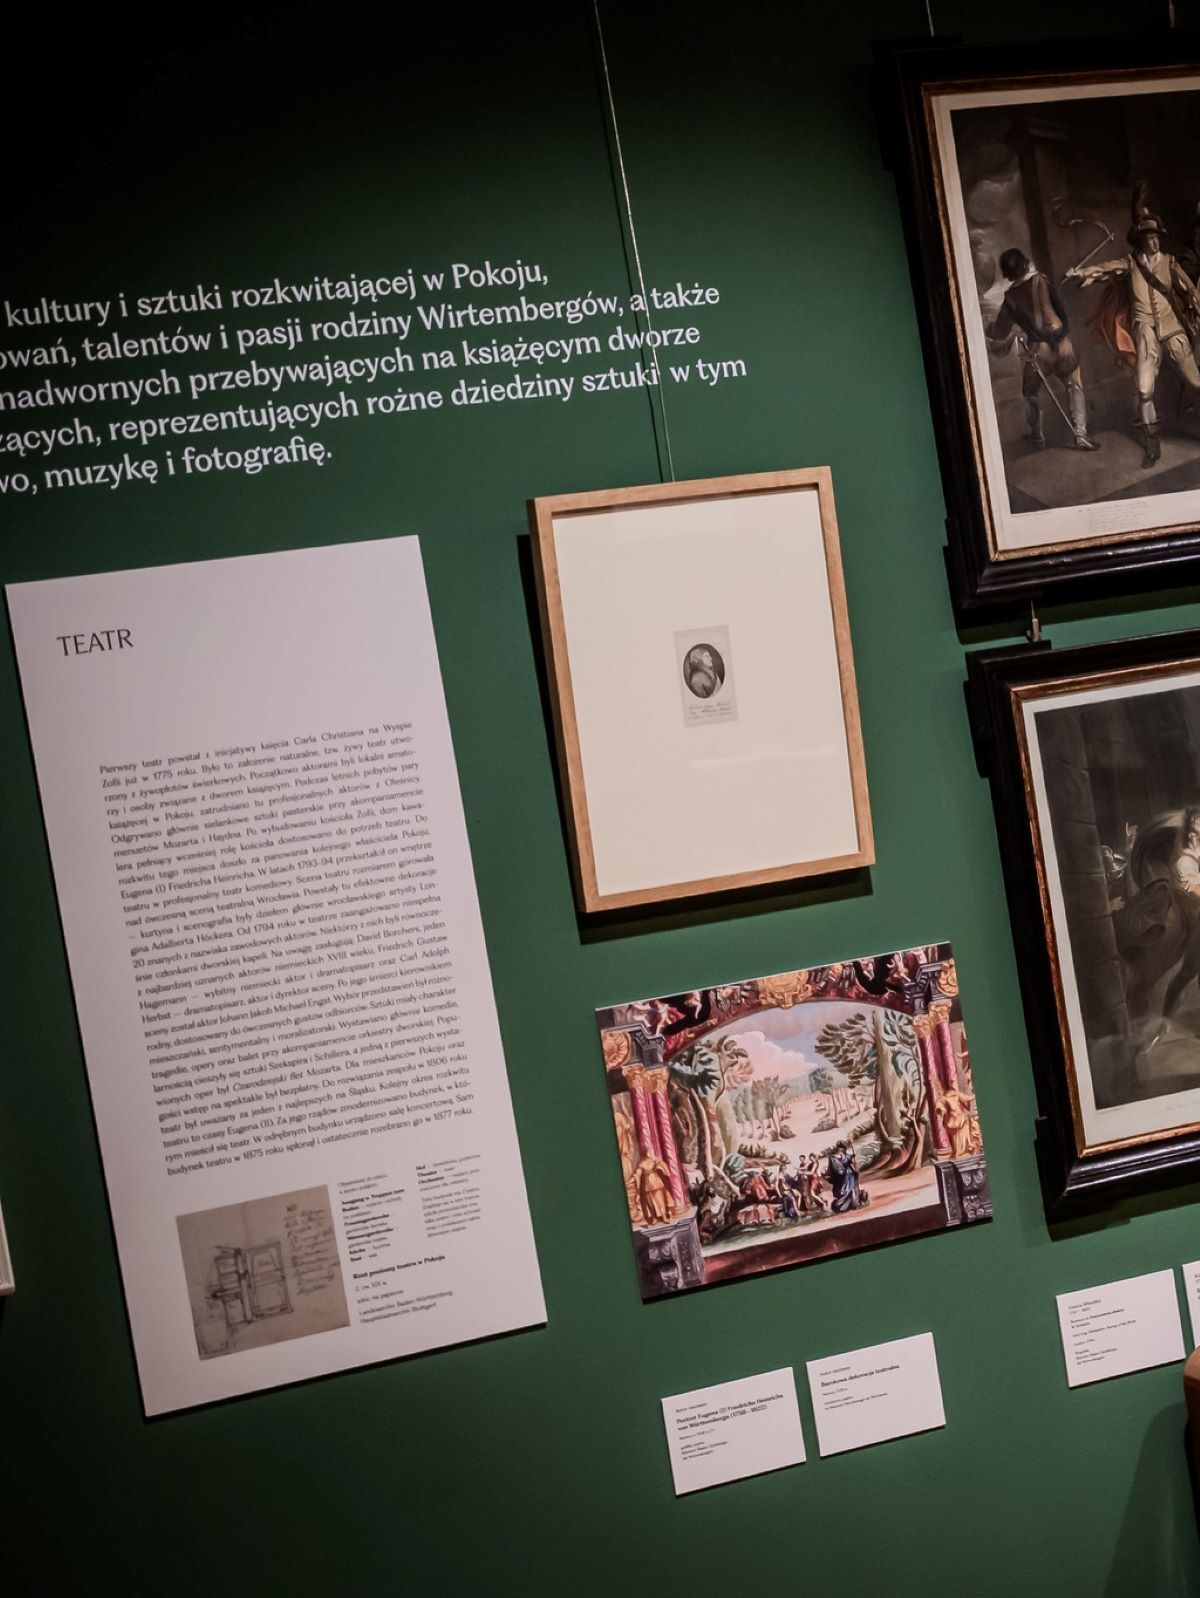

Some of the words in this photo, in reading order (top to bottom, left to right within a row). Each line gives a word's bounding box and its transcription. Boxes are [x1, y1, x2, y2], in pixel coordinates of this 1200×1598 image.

[5, 298, 110, 327] kultury
[119, 293, 128, 317] i
[137, 285, 223, 316] sztuki
[231, 269, 416, 308] rozkwitającej
[422, 273, 444, 291] w
[451, 260, 549, 291] Pokoju,
[82, 327, 211, 361] talentów
[220, 324, 228, 349] i
[236, 318, 303, 355] pasji
[311, 311, 412, 341] rodziny
[416, 290, 624, 330] Wirtembergów,
[630, 294, 645, 311] a
[650, 282, 720, 310] także
[0, 369, 181, 410] nadwornych
[189, 347, 415, 399] przebywających
[421, 350, 457, 370] na
[461, 337, 601, 368] książęcym
[608, 325, 701, 352] dworze
[109, 392, 359, 445] reprezentujących
[366, 387, 443, 415] rożne
[451, 373, 575, 406] dziedziny
[582, 362, 659, 393] sztuki
[669, 365, 690, 383] w
[695, 358, 747, 386] tym
[44, 454, 158, 489] muzykę
[166, 451, 175, 475] i
[181, 436, 332, 475] fotografię.
[56, 628, 134, 657] TEATR
